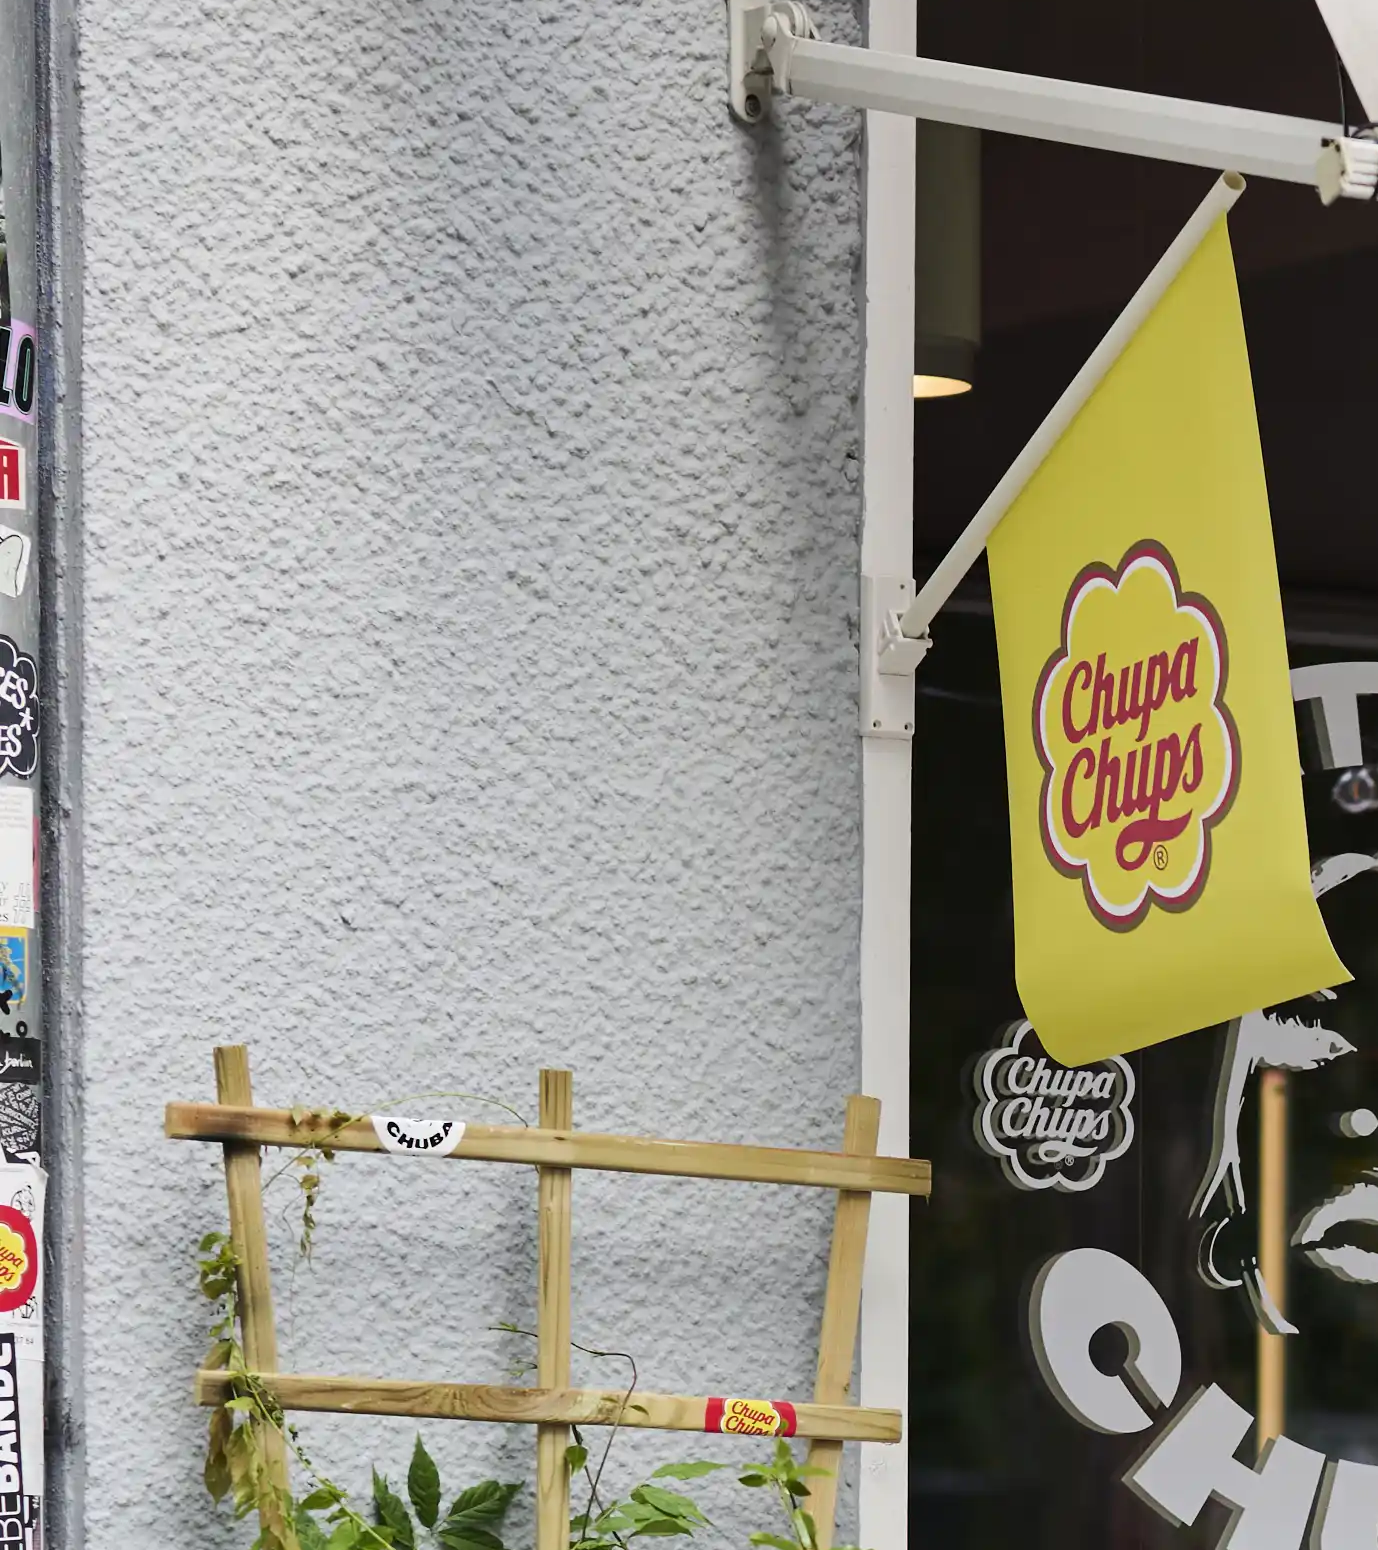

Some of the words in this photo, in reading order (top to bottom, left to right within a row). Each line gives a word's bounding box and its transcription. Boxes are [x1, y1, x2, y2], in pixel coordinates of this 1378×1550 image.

[1061, 636, 1200, 745] Chupa
[1061, 722, 1204, 872] Chups
[1007, 1055, 1117, 1108] Chupa
[386, 1121, 453, 1150] CHUBA
[1001, 1096, 1113, 1163] Chups
[731, 1400, 776, 1426] Chupa
